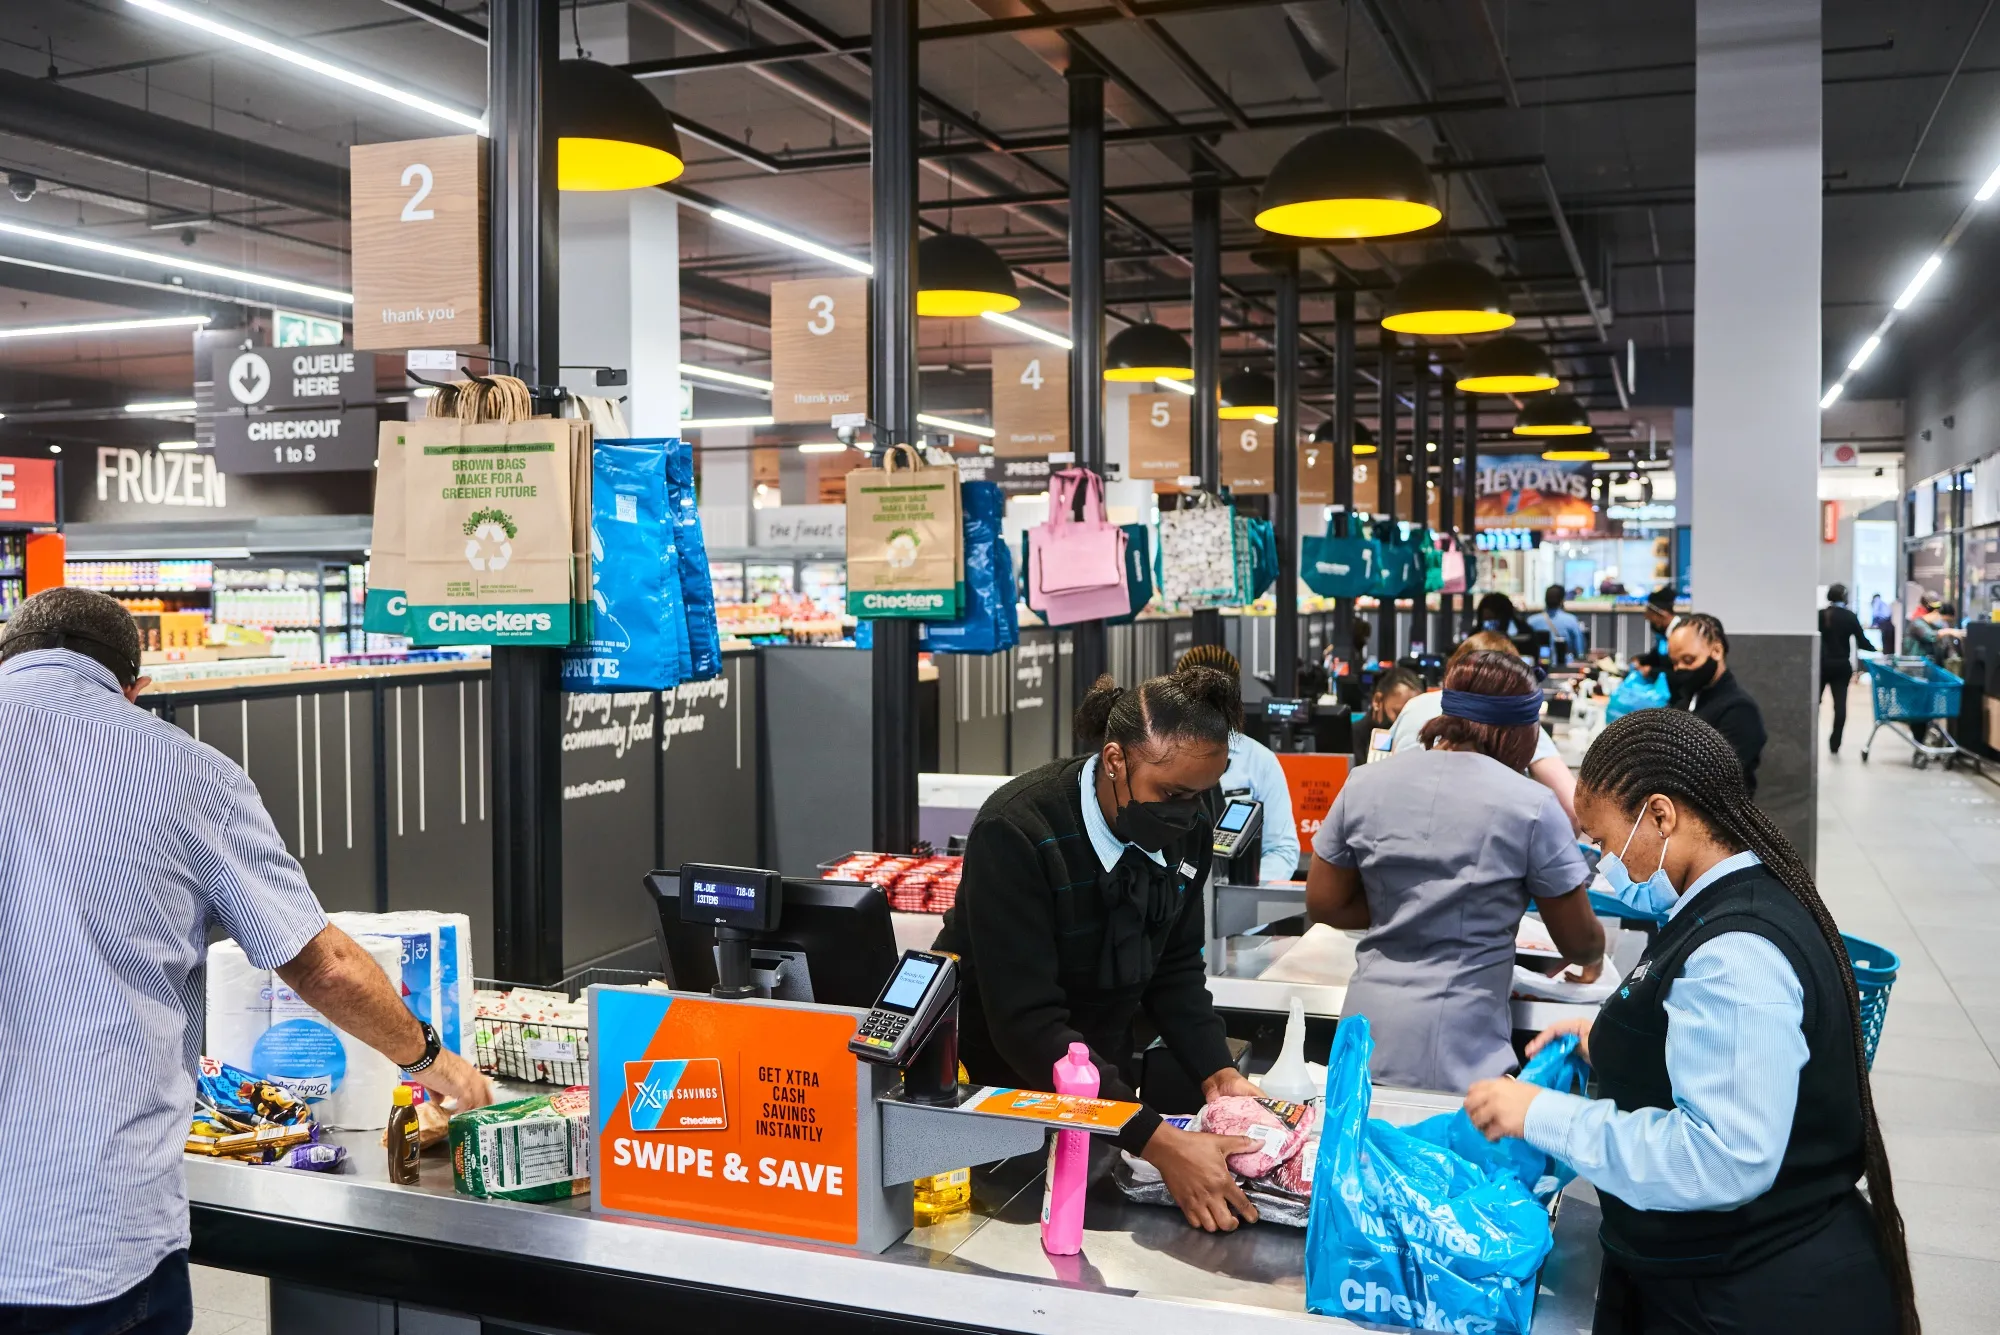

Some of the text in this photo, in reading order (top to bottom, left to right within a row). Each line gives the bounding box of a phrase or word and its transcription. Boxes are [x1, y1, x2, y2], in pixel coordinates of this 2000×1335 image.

[400, 163, 434, 222] 2
[382, 307, 455, 323] thank you
[807, 294, 836, 335] 3
[292, 353, 355, 375] QUEUE
[1020, 359, 1044, 390] 4
[293, 376, 341, 397] HERE
[794, 393, 850, 404] thank you
[1151, 402, 1170, 427] 5
[247, 419, 341, 441] CHECKOUT
[1240, 429, 1258, 452] 6
[273, 445, 316, 463] 1 to 5
[452, 458, 526, 471] BROWN BAGS
[97, 446, 226, 508] FROZEN
[455, 472, 524, 485] MAKE FOR A
[442, 486, 537, 499] GREENER FUTURE
[863, 593, 943, 609] Checkers
[428, 610, 552, 632] Checkers
[562, 719, 626, 758] community
[626, 710, 655, 750] food
[758, 1066, 819, 1087] GET XTRA
[297, 1080, 328, 1096] Baby
[676, 1088, 718, 1100] SAVINGS
[773, 1086, 805, 1104] CASH
[1018, 1090, 1117, 1107] SIGN UP NOW
[680, 1117, 722, 1125] Checkers
[763, 1102, 816, 1123] SAVINGS
[756, 1120, 823, 1142] INSTANTLY
[613, 1138, 713, 1178] SWIPE
[723, 1152, 749, 1183] &
[758, 1157, 843, 1195] SAVE
